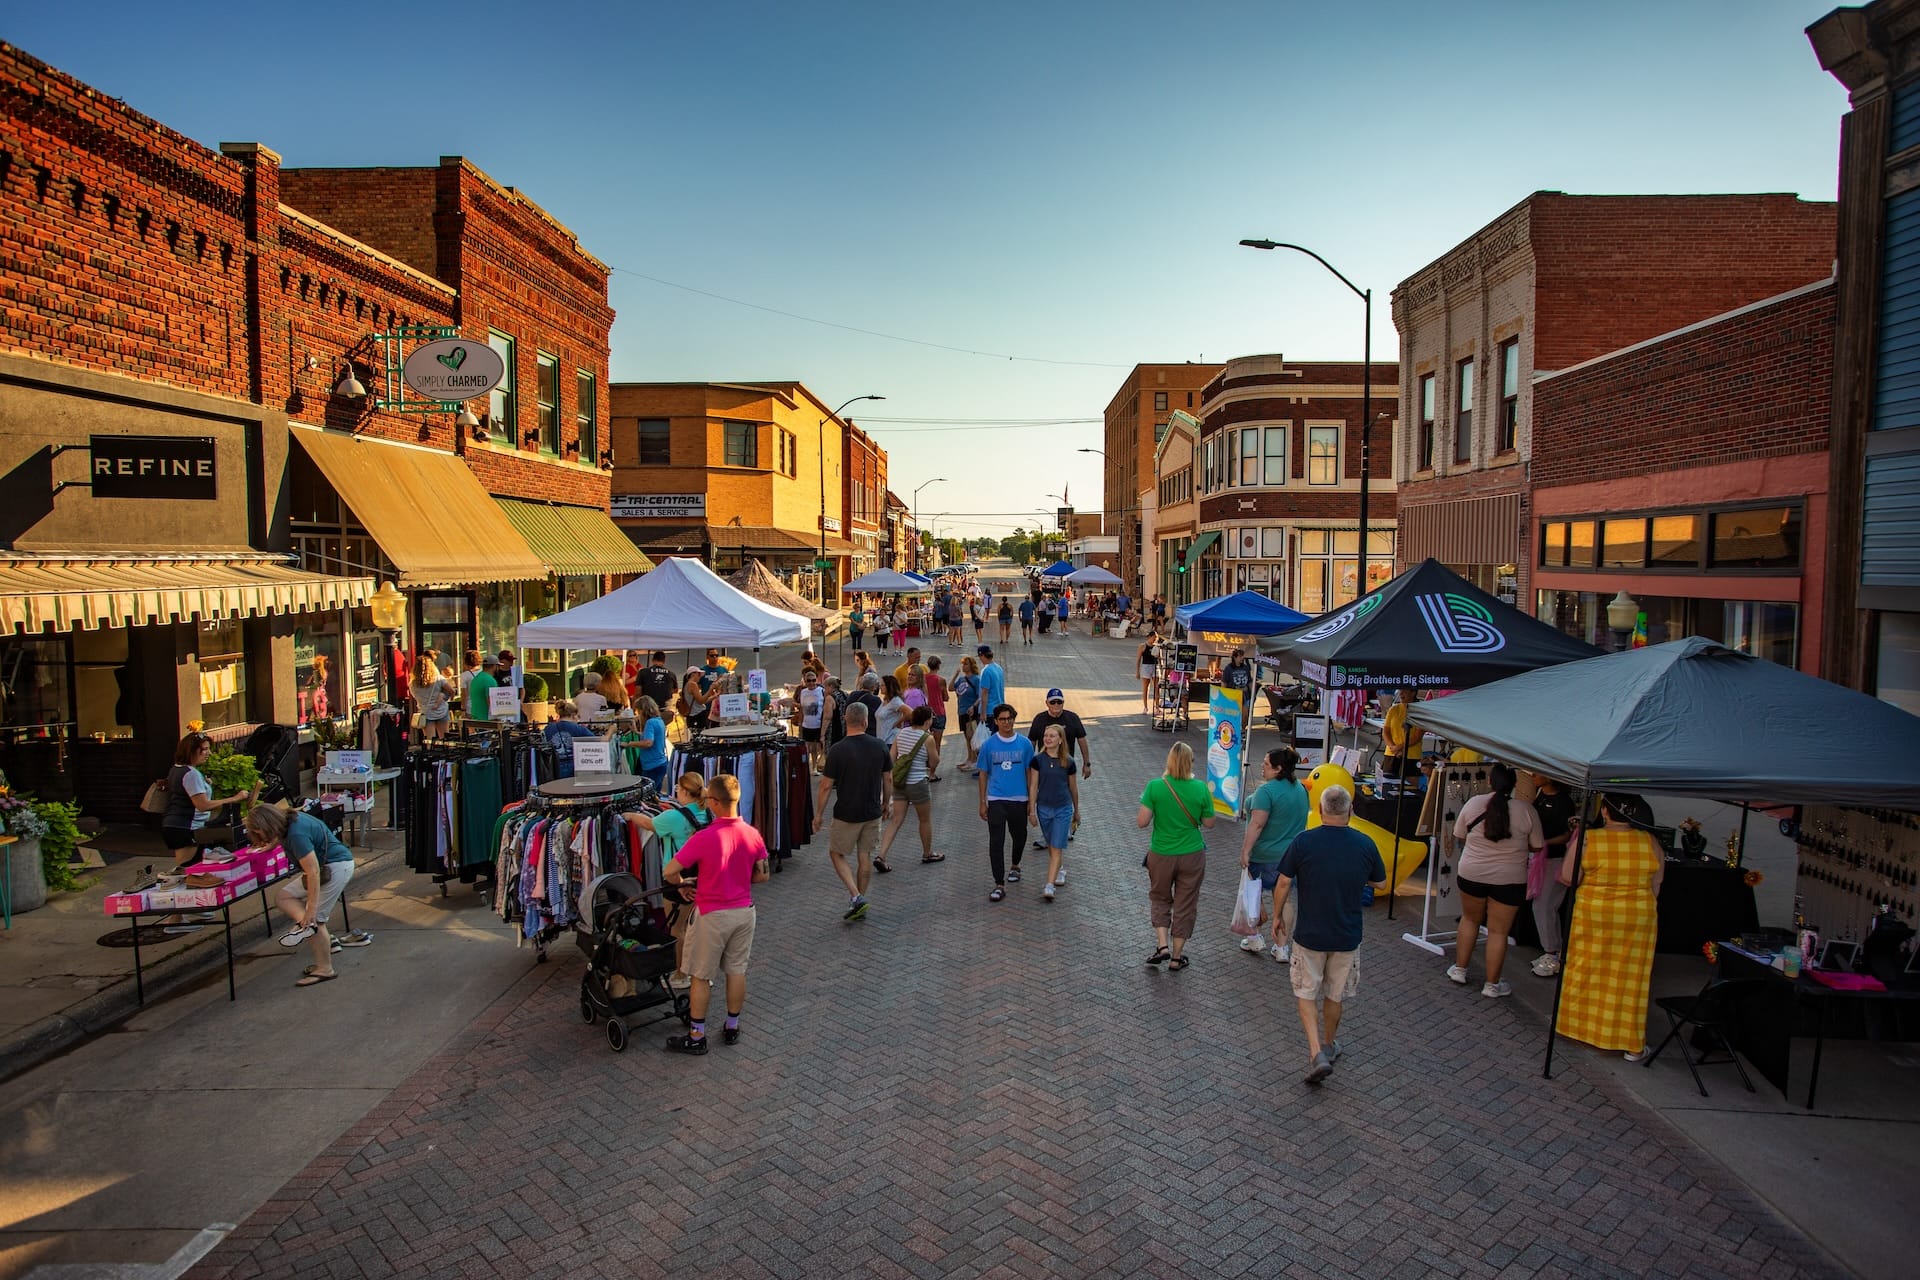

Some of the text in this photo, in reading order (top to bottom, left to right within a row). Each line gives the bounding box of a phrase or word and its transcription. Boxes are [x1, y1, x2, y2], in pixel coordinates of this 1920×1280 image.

[416, 375, 488, 388] SIMPLY CHARMED
[94, 457, 213, 477] REFINE
[1347, 674, 1449, 687] Big Brothers Big Sisters
